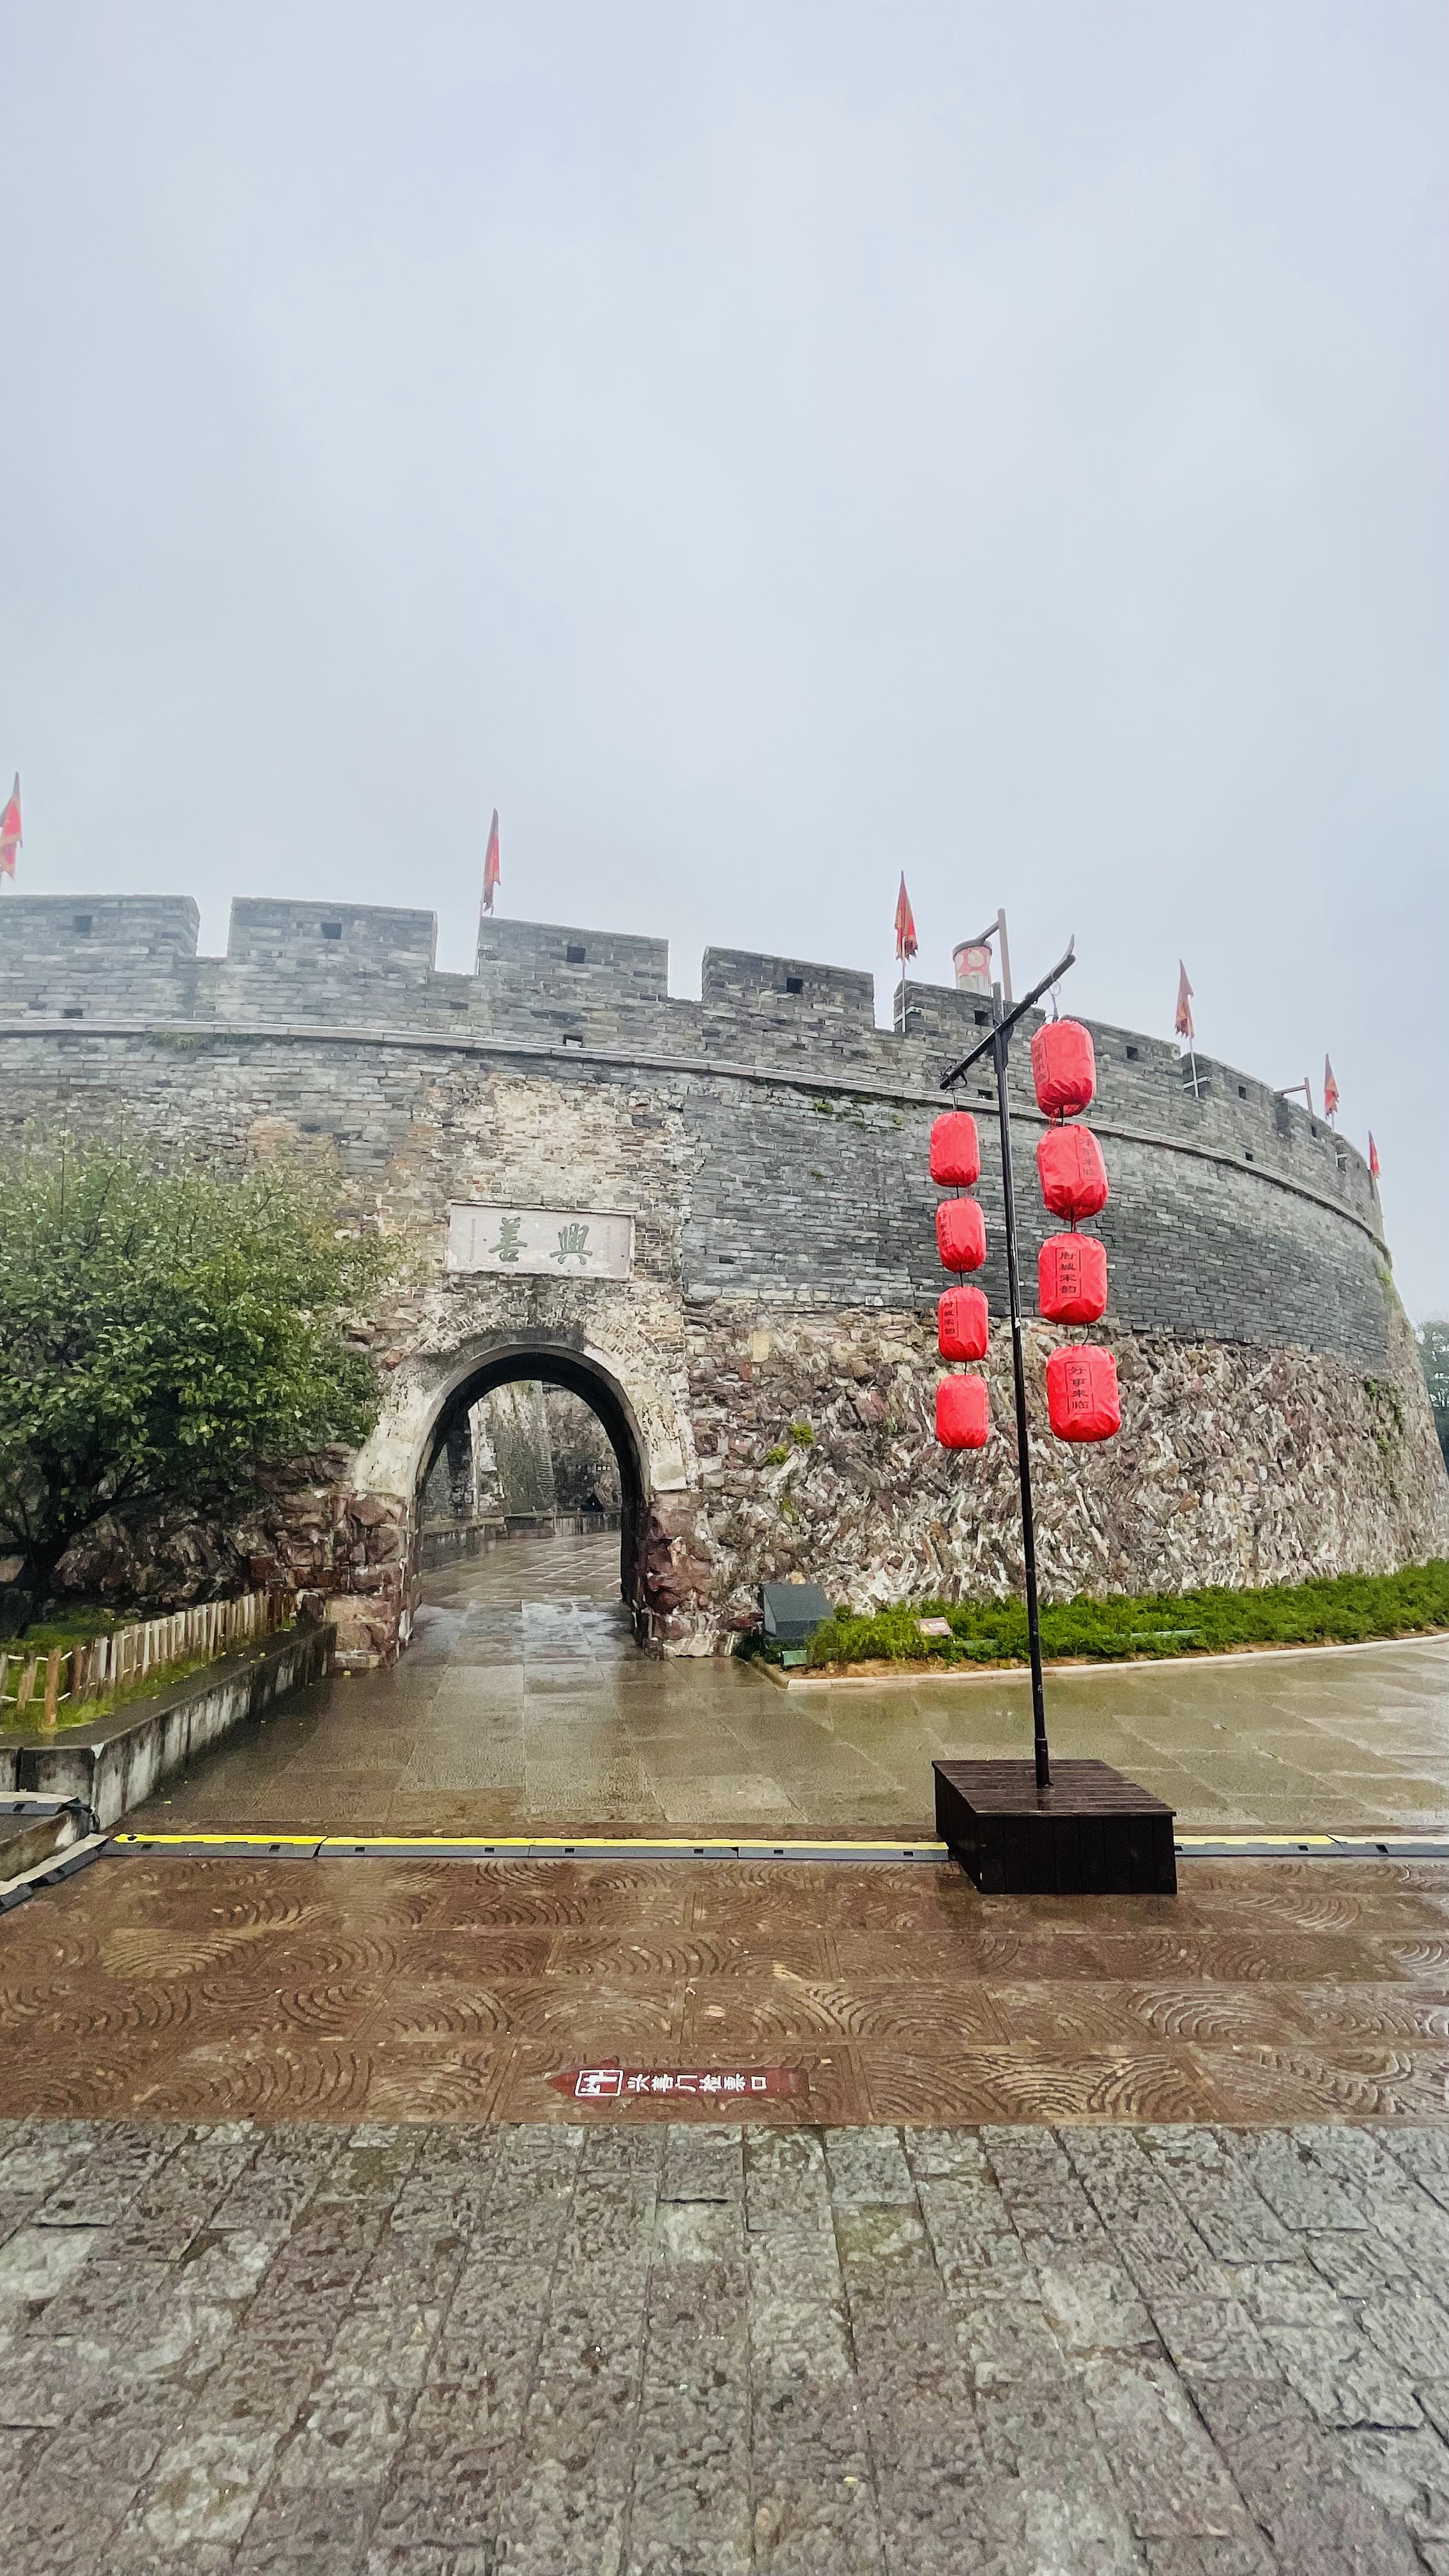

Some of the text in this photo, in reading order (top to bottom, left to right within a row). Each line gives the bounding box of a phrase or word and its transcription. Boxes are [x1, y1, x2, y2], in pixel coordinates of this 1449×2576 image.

[626, 2073, 768, 2093] 兴善门检票口
